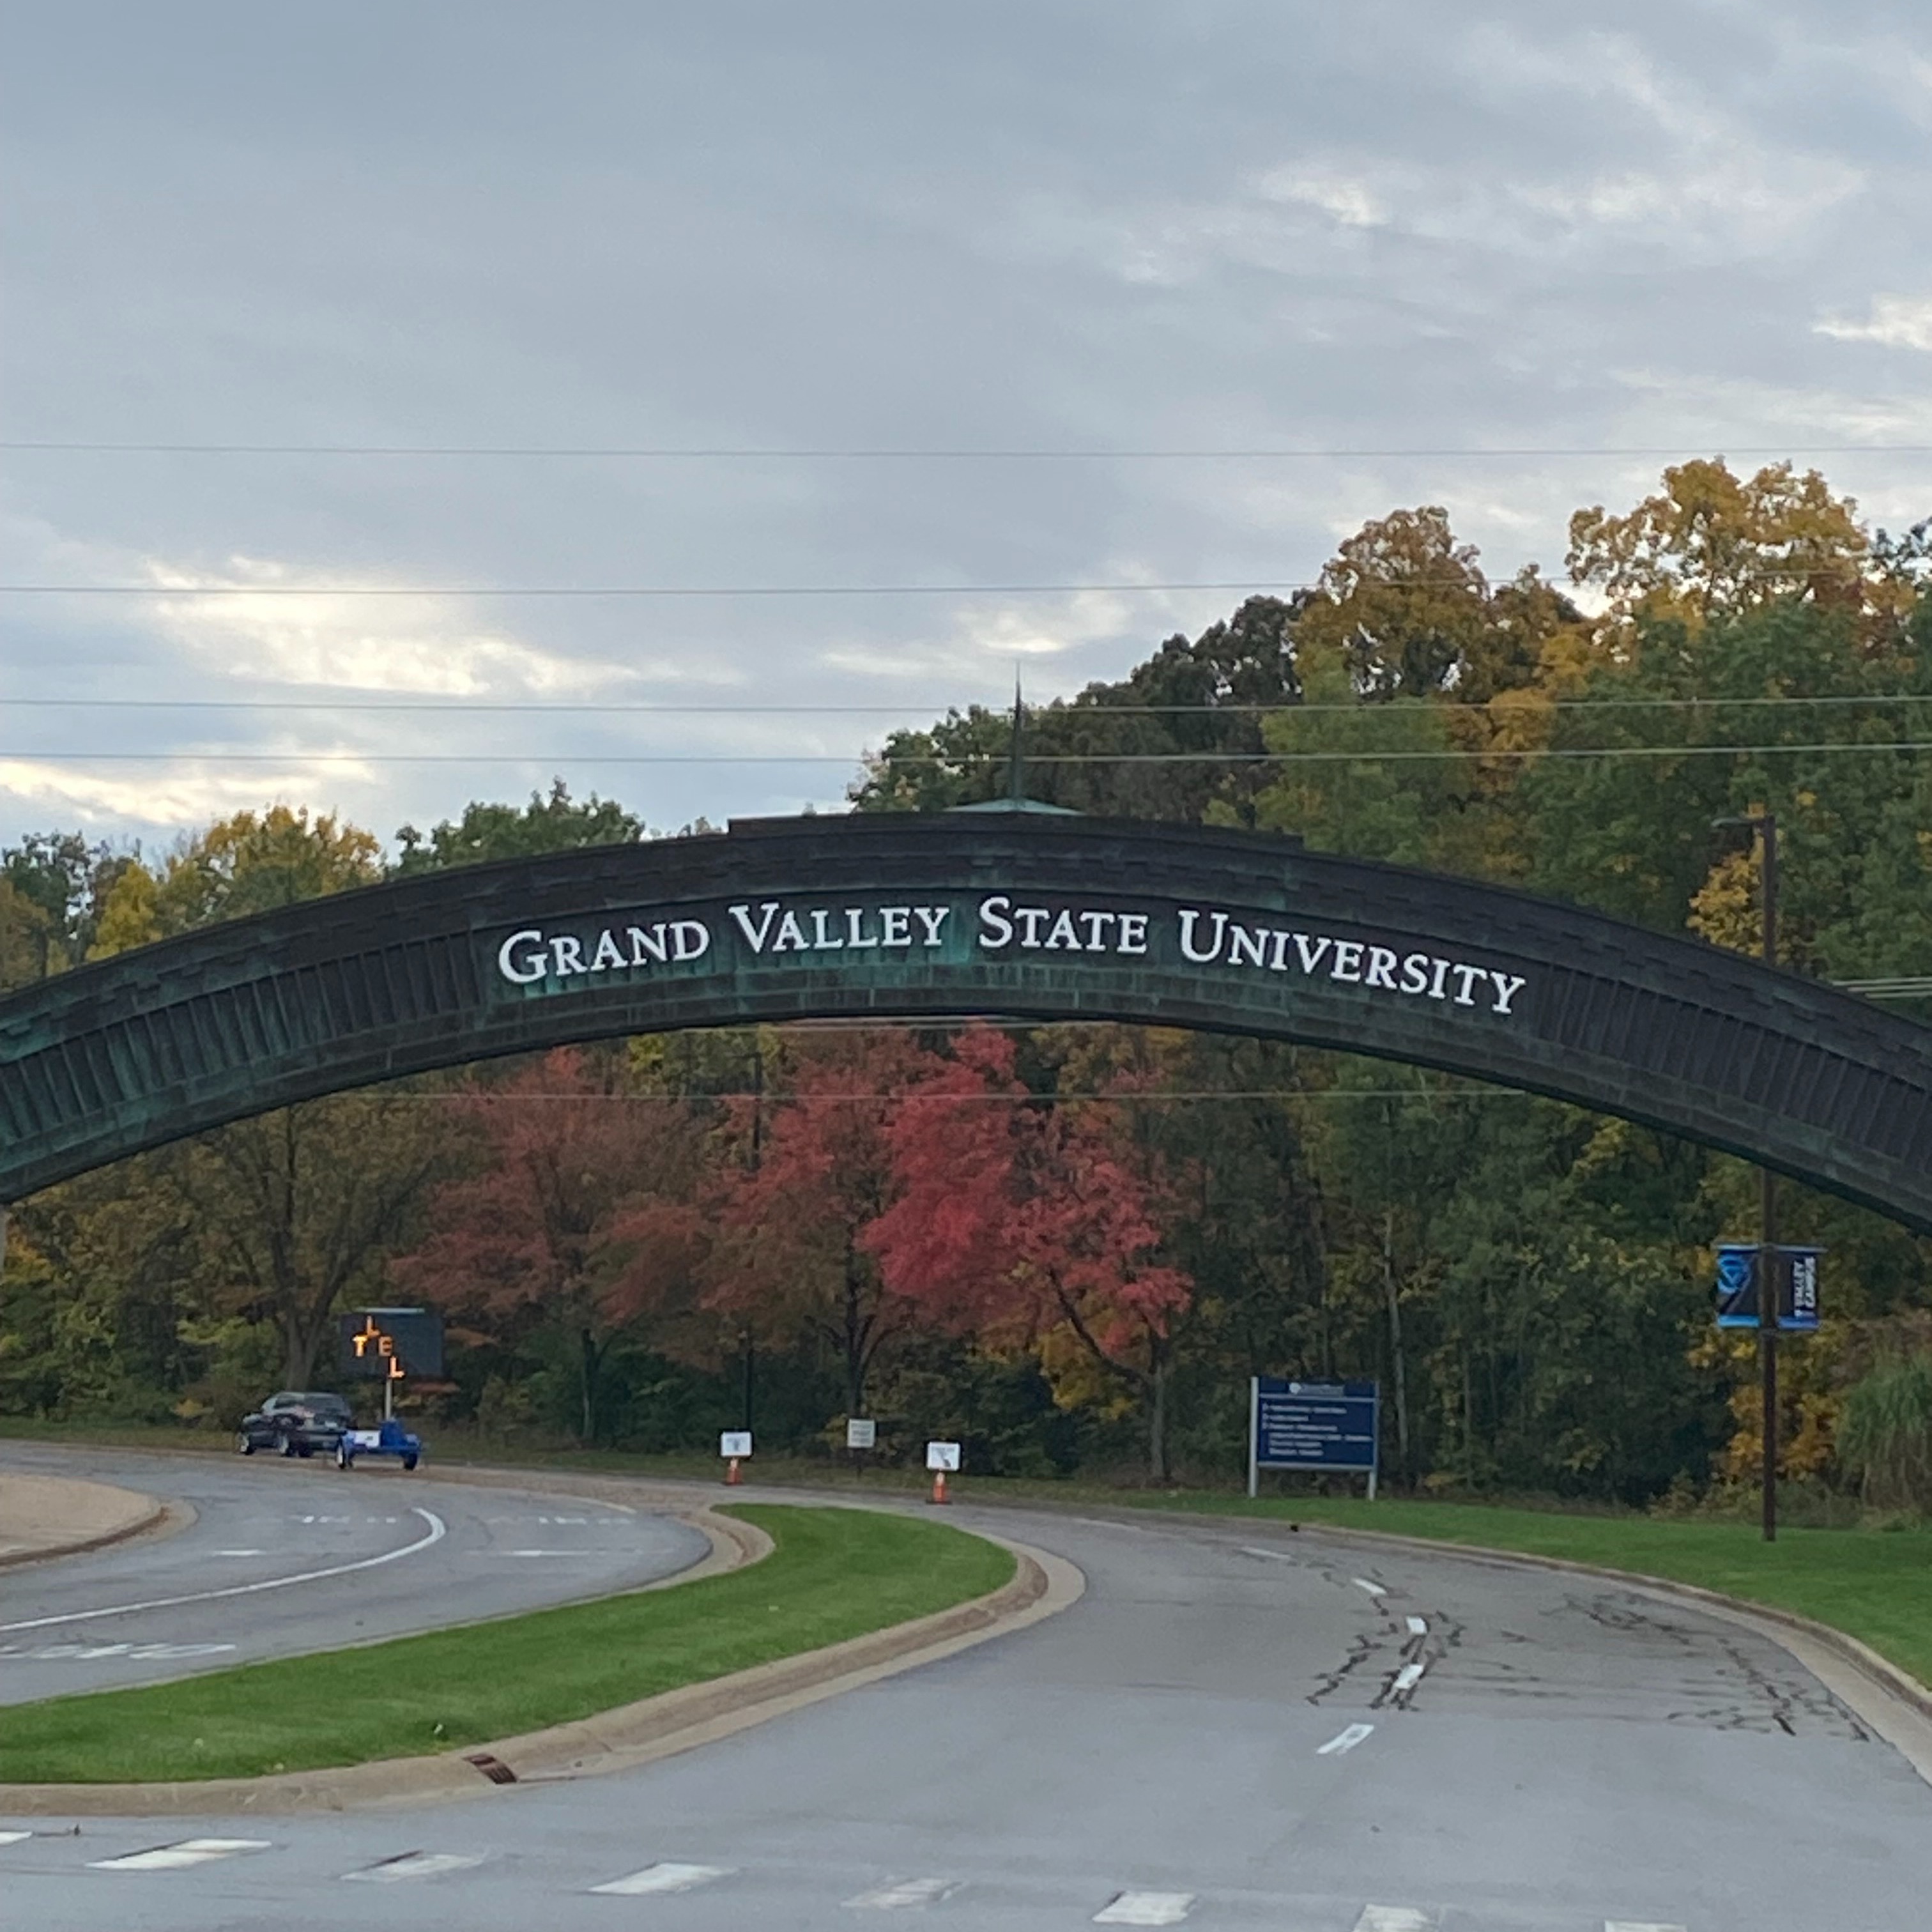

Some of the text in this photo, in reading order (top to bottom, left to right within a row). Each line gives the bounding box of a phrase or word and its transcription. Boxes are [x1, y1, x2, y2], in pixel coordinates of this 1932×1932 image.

[498, 896, 1526, 1014] GRAND VALLEY STATE UNIVERSITY
